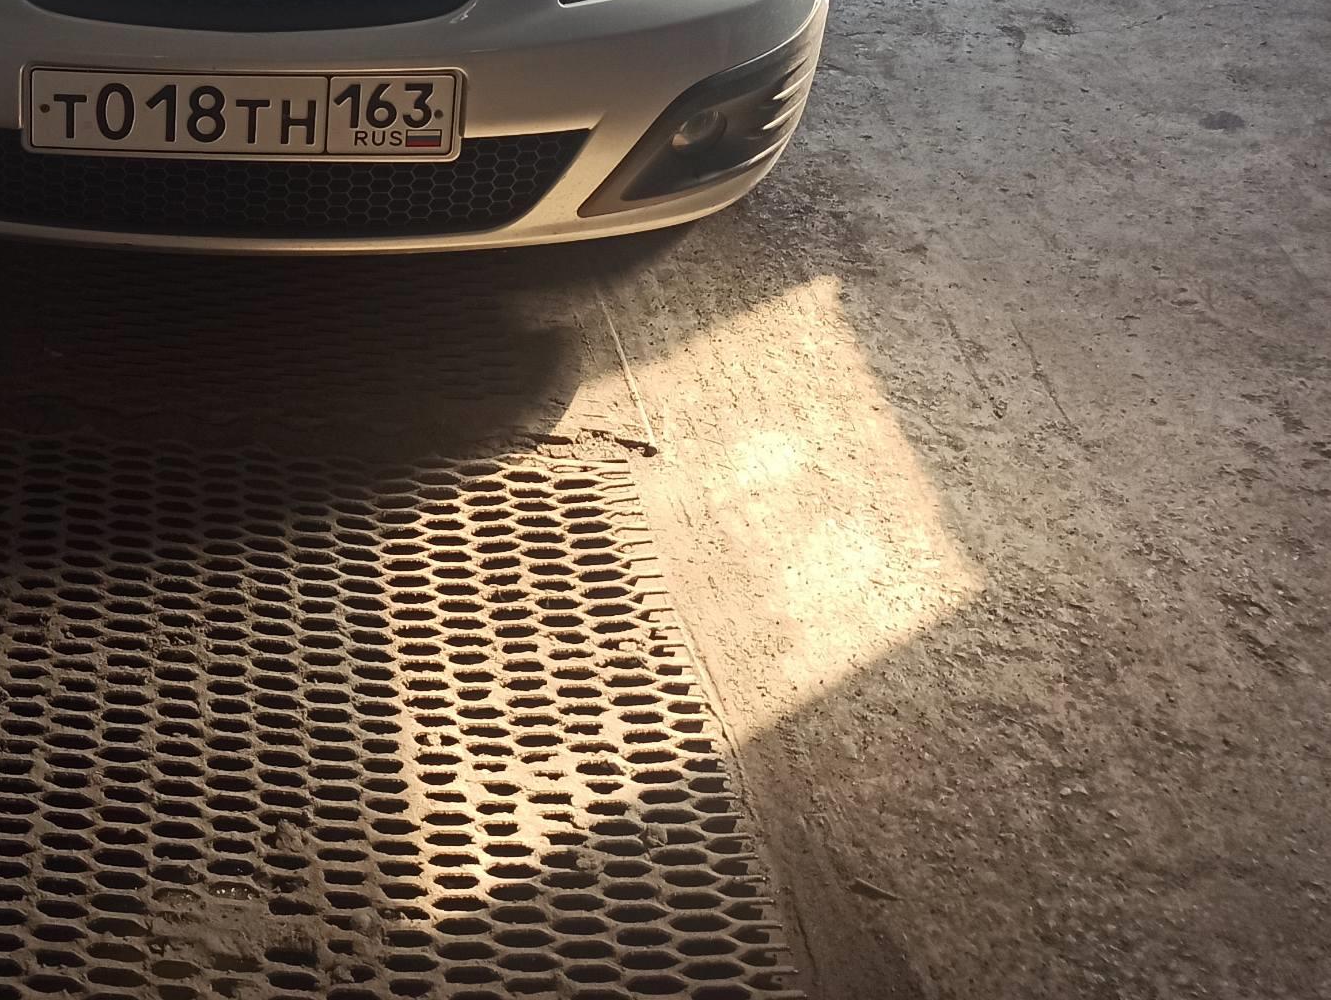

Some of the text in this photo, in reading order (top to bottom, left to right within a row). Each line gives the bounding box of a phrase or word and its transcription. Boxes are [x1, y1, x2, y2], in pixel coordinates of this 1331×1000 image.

[52, 82, 434, 145] Т018ТН 163
[353, 130, 403, 147] RUS
